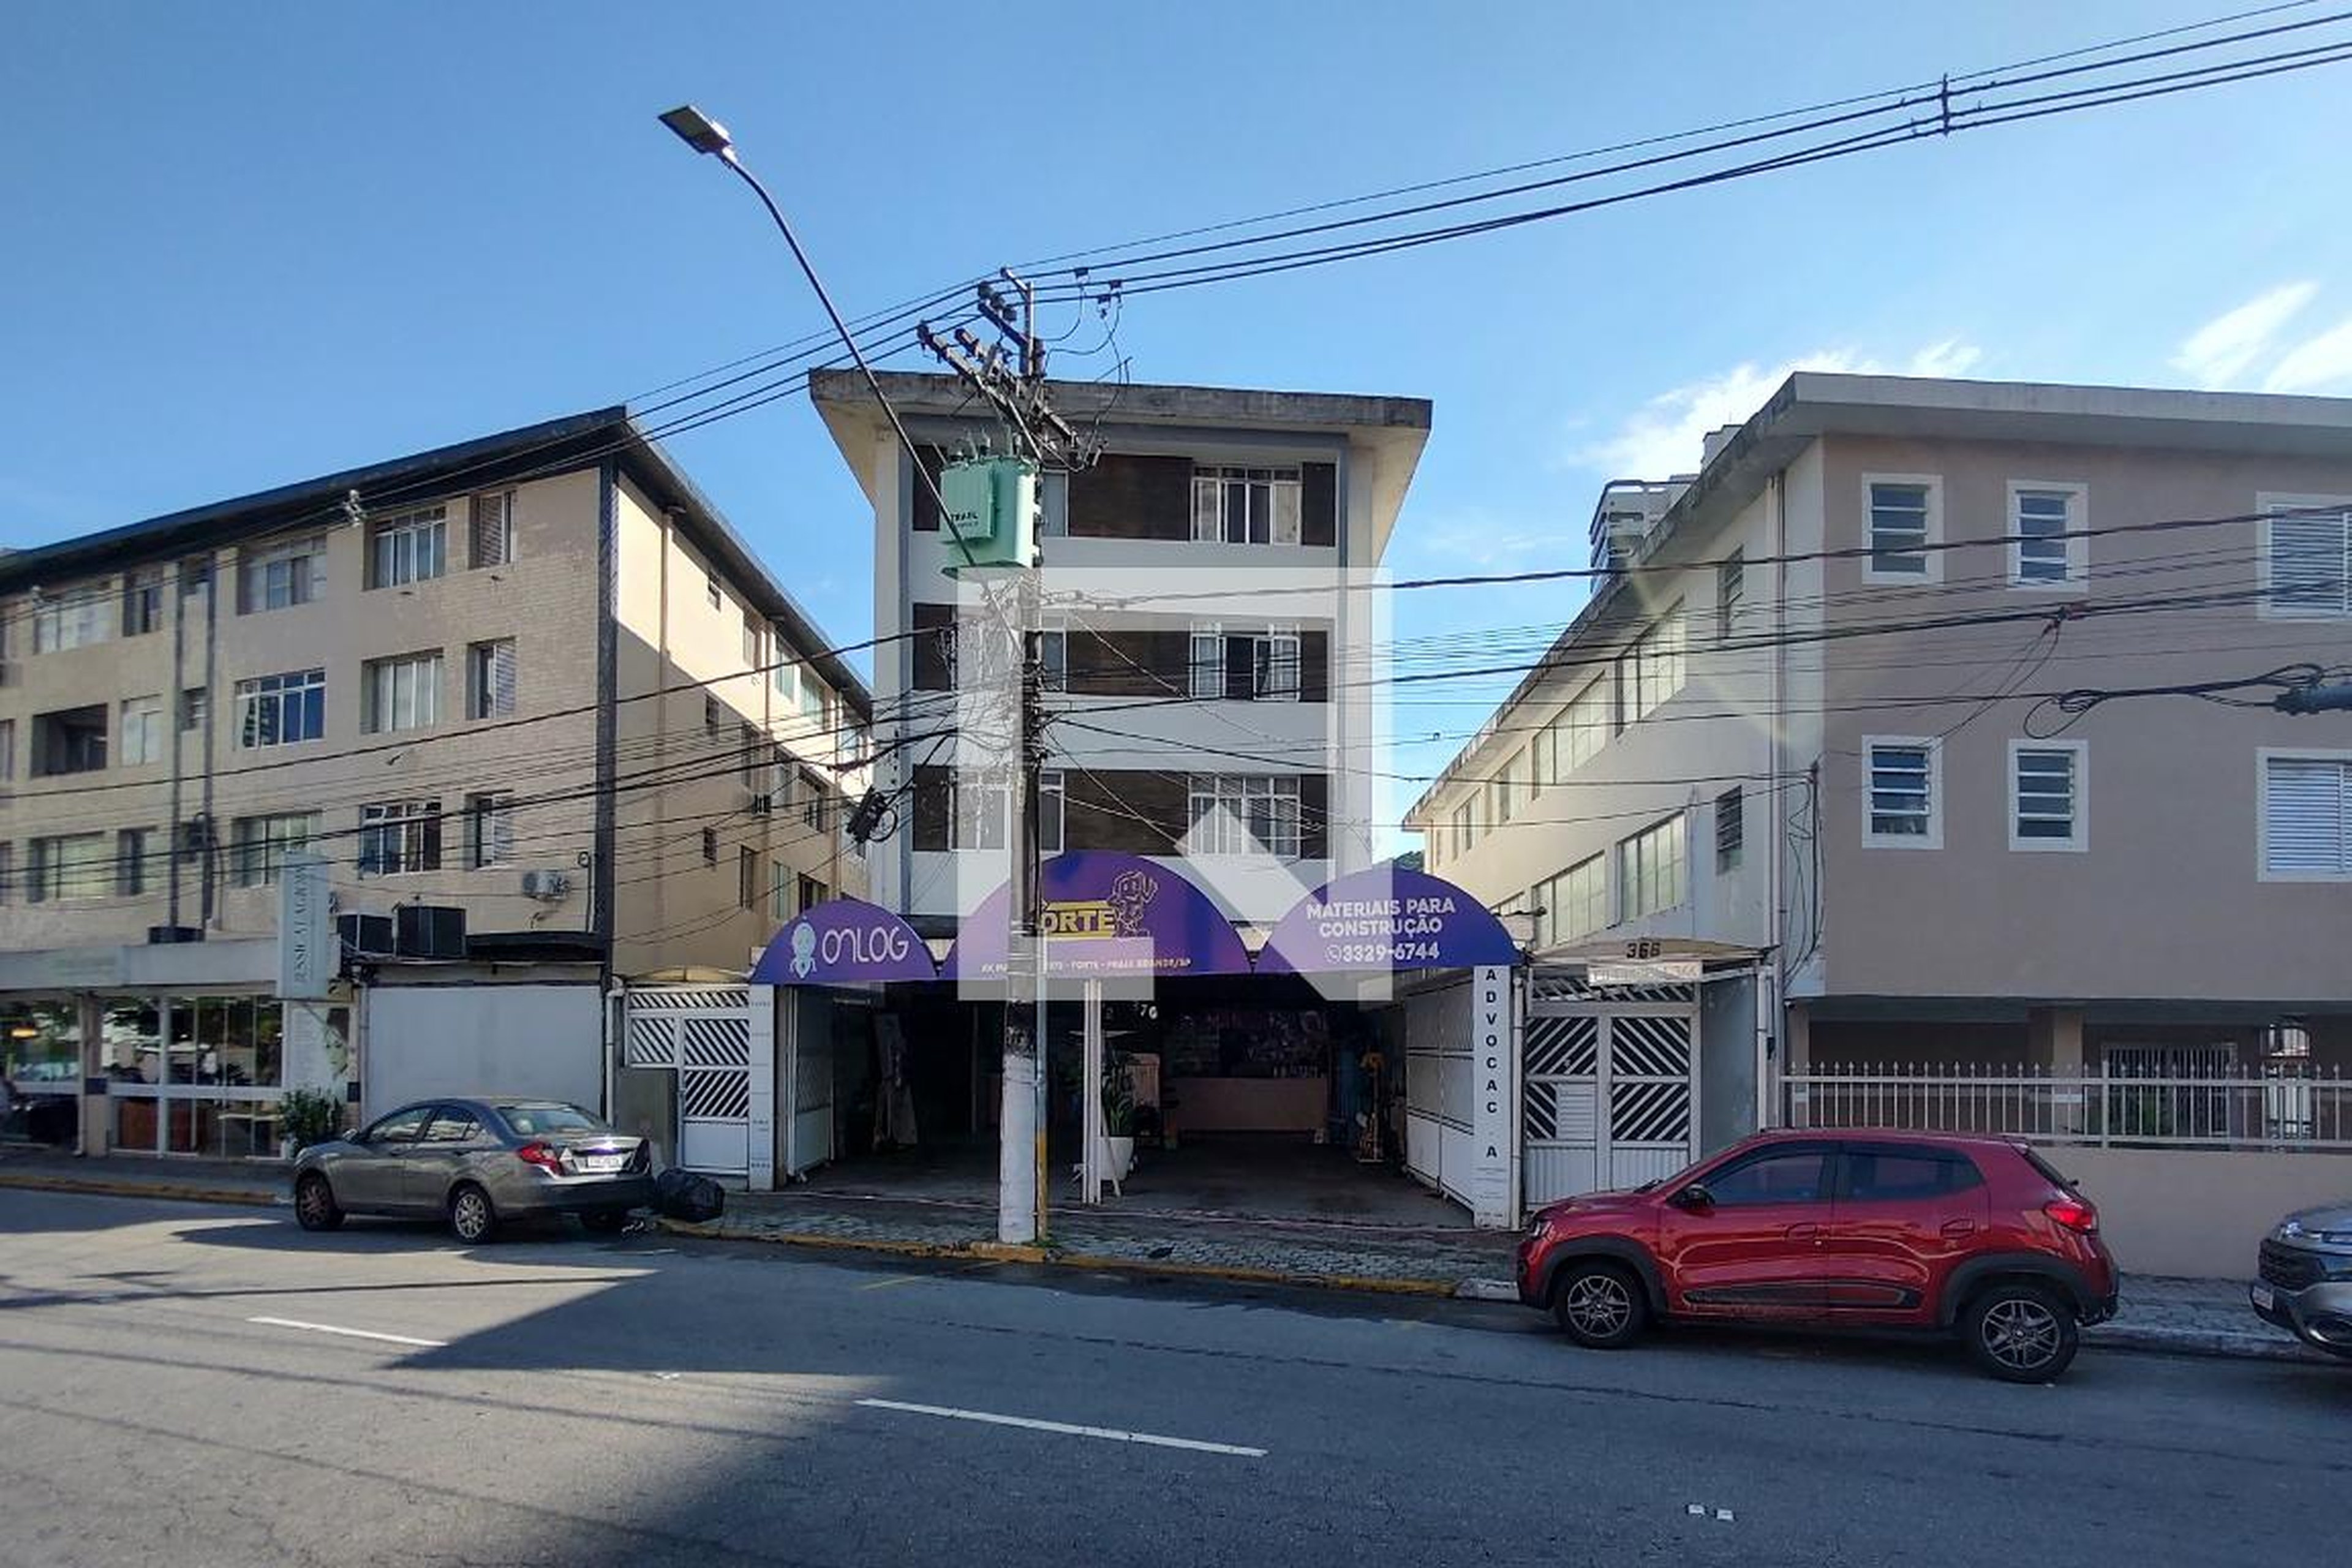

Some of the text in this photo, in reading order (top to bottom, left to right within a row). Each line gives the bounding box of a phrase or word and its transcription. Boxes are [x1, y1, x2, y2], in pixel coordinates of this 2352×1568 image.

[1306, 898, 1455, 919] MATERIAIS PARA
[1040, 910, 1115, 932] ORTE
[1319, 914, 1442, 938] CONSTRUÇÃO
[1343, 941, 1439, 962] 3329-6744
